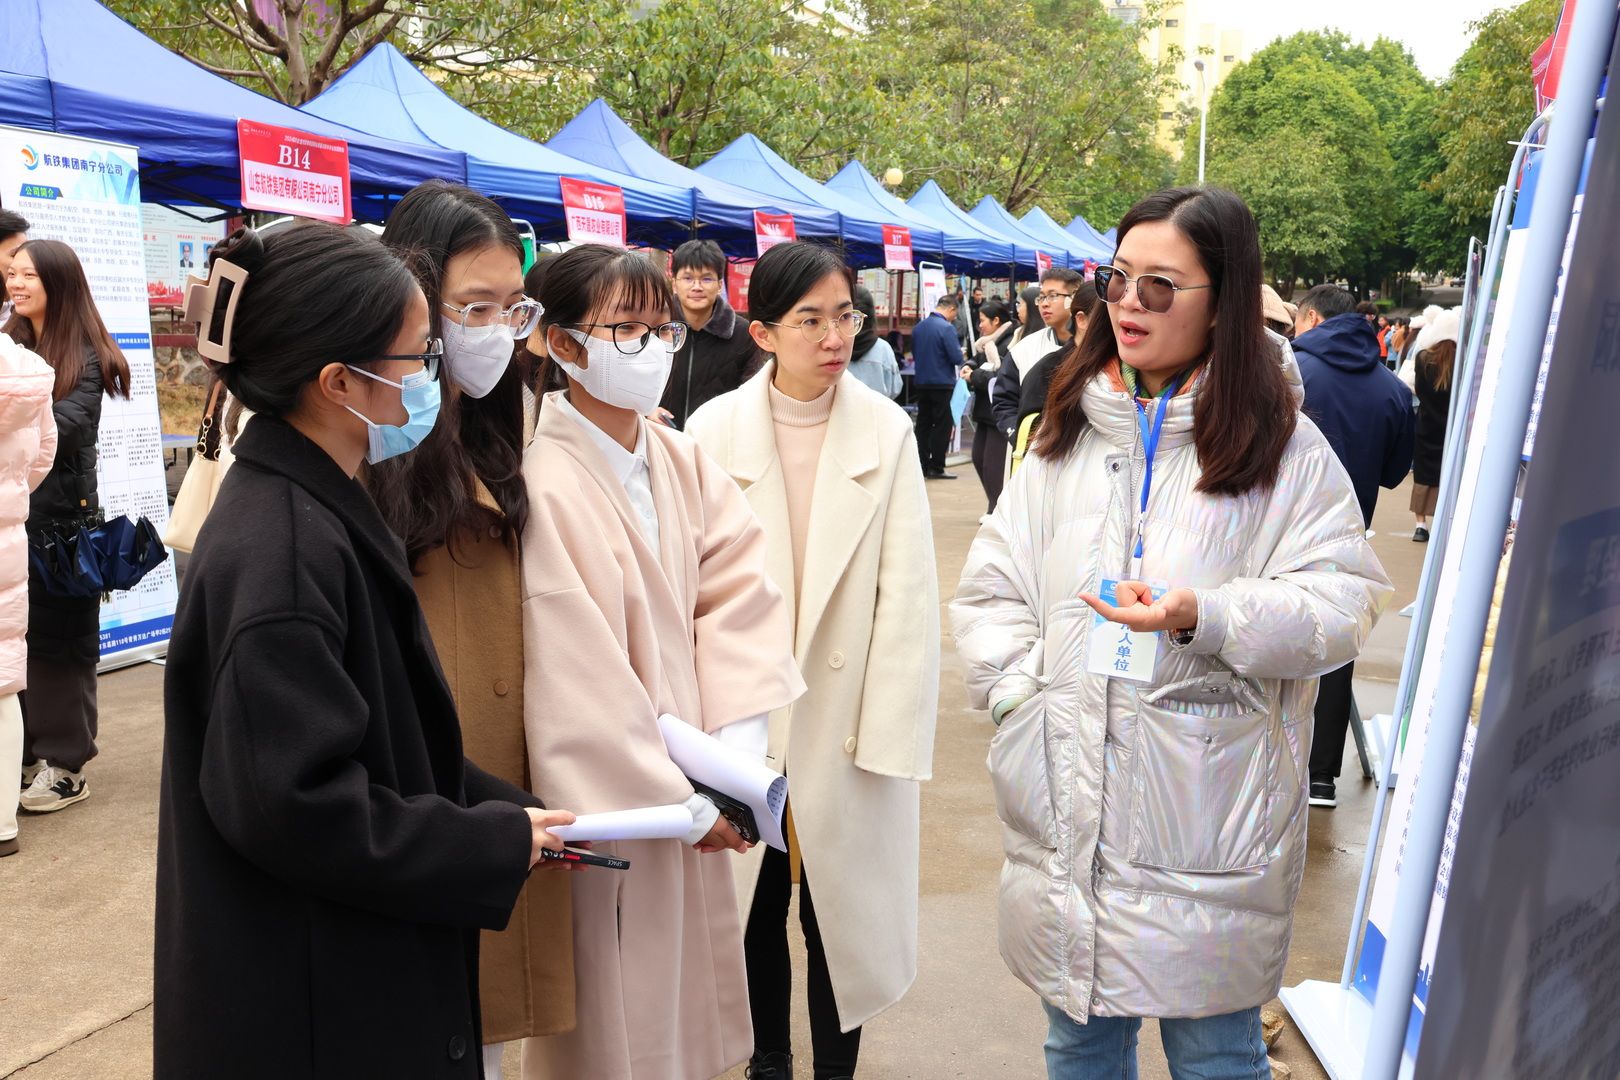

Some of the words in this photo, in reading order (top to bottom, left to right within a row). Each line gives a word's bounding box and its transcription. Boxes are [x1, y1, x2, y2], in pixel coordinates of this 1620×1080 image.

[43, 153, 123, 175] 航铁集团南宁分公司
[278, 144, 311, 170] B14
[25, 186, 55, 199] 公司简介
[249, 171, 339, 205] 山东航铁集团有限公司南宁分公司
[583, 193, 605, 211] B15
